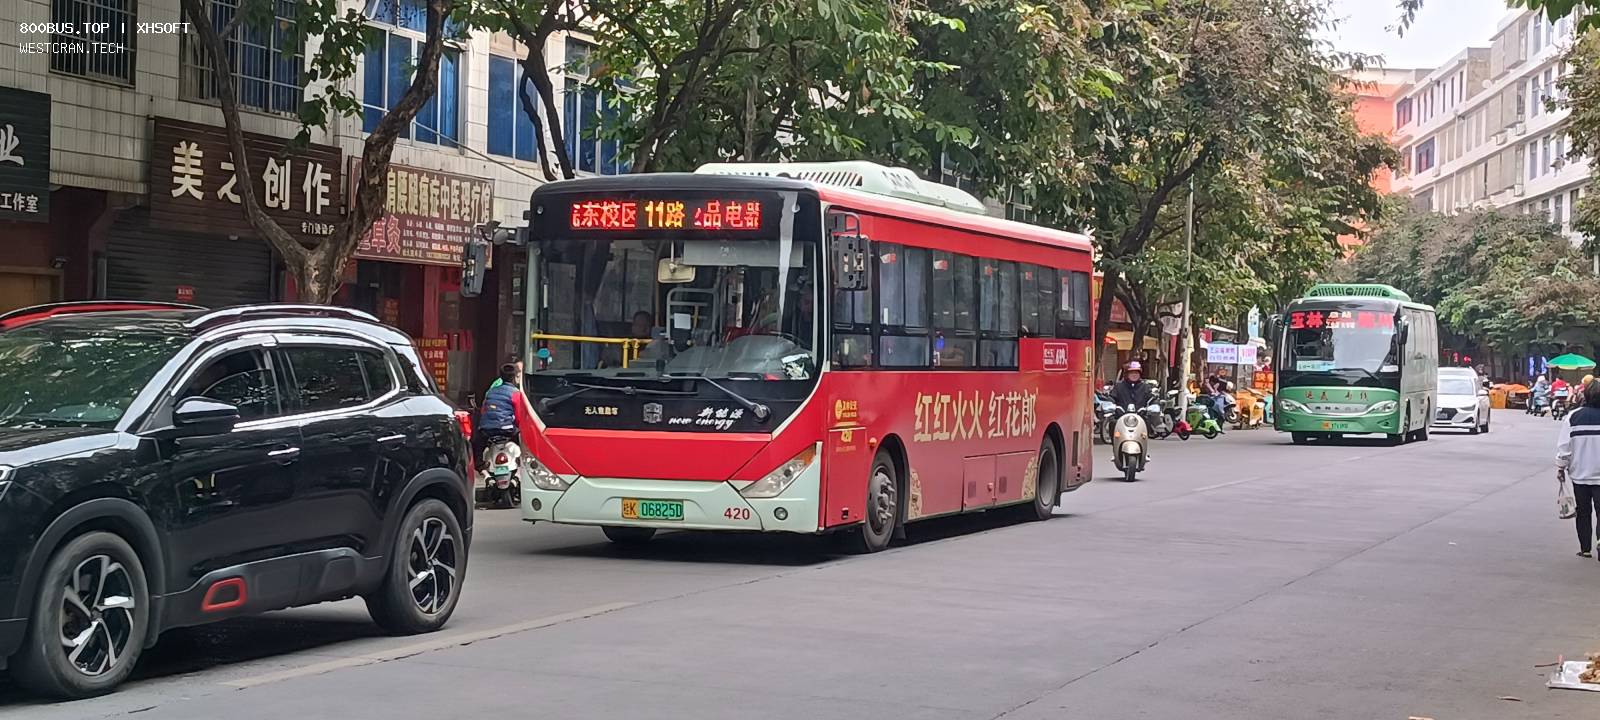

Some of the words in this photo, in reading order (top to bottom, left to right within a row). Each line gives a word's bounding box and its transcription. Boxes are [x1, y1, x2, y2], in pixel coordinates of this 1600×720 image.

[0, 192, 39, 213] 工作室
[383, 167, 491, 223] 肩腰腿痛症中医理疗馆
[645, 201, 685, 228] 11路
[1289, 311, 1322, 329] 玉林
[913, 390, 983, 442] 红红火火
[988, 387, 1037, 439] 红花郎
[723, 507, 751, 520] 420
